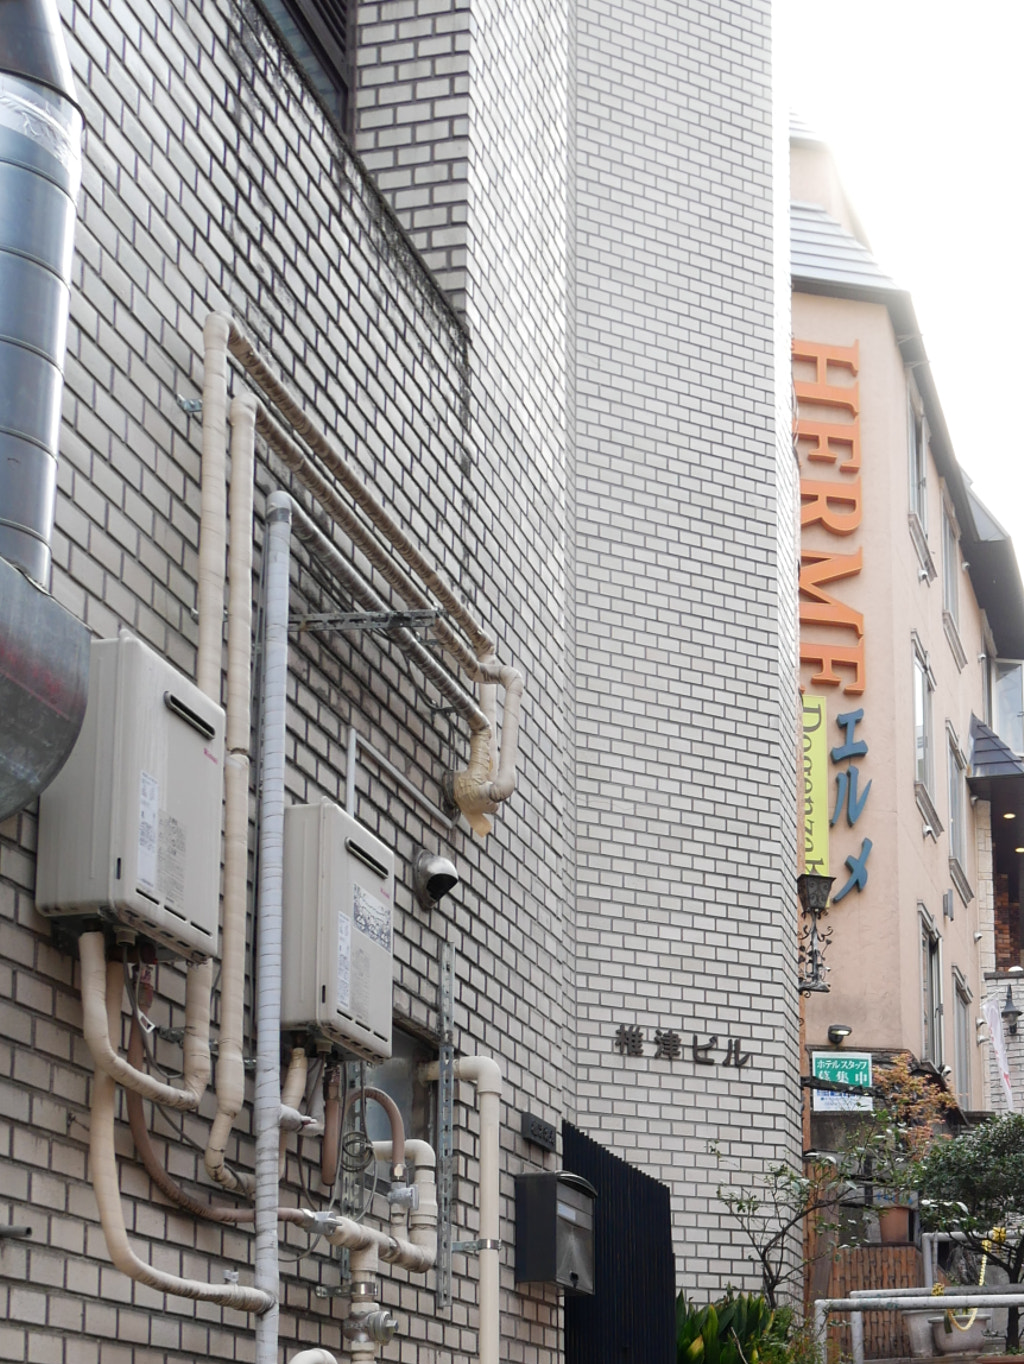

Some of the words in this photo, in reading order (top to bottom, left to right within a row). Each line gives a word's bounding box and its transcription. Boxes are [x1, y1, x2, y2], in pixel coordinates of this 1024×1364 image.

[791, 338, 866, 697] HERME
[830, 707, 873, 904] エルメ
[816, 1060, 868, 1070] ホテルスタッフ
